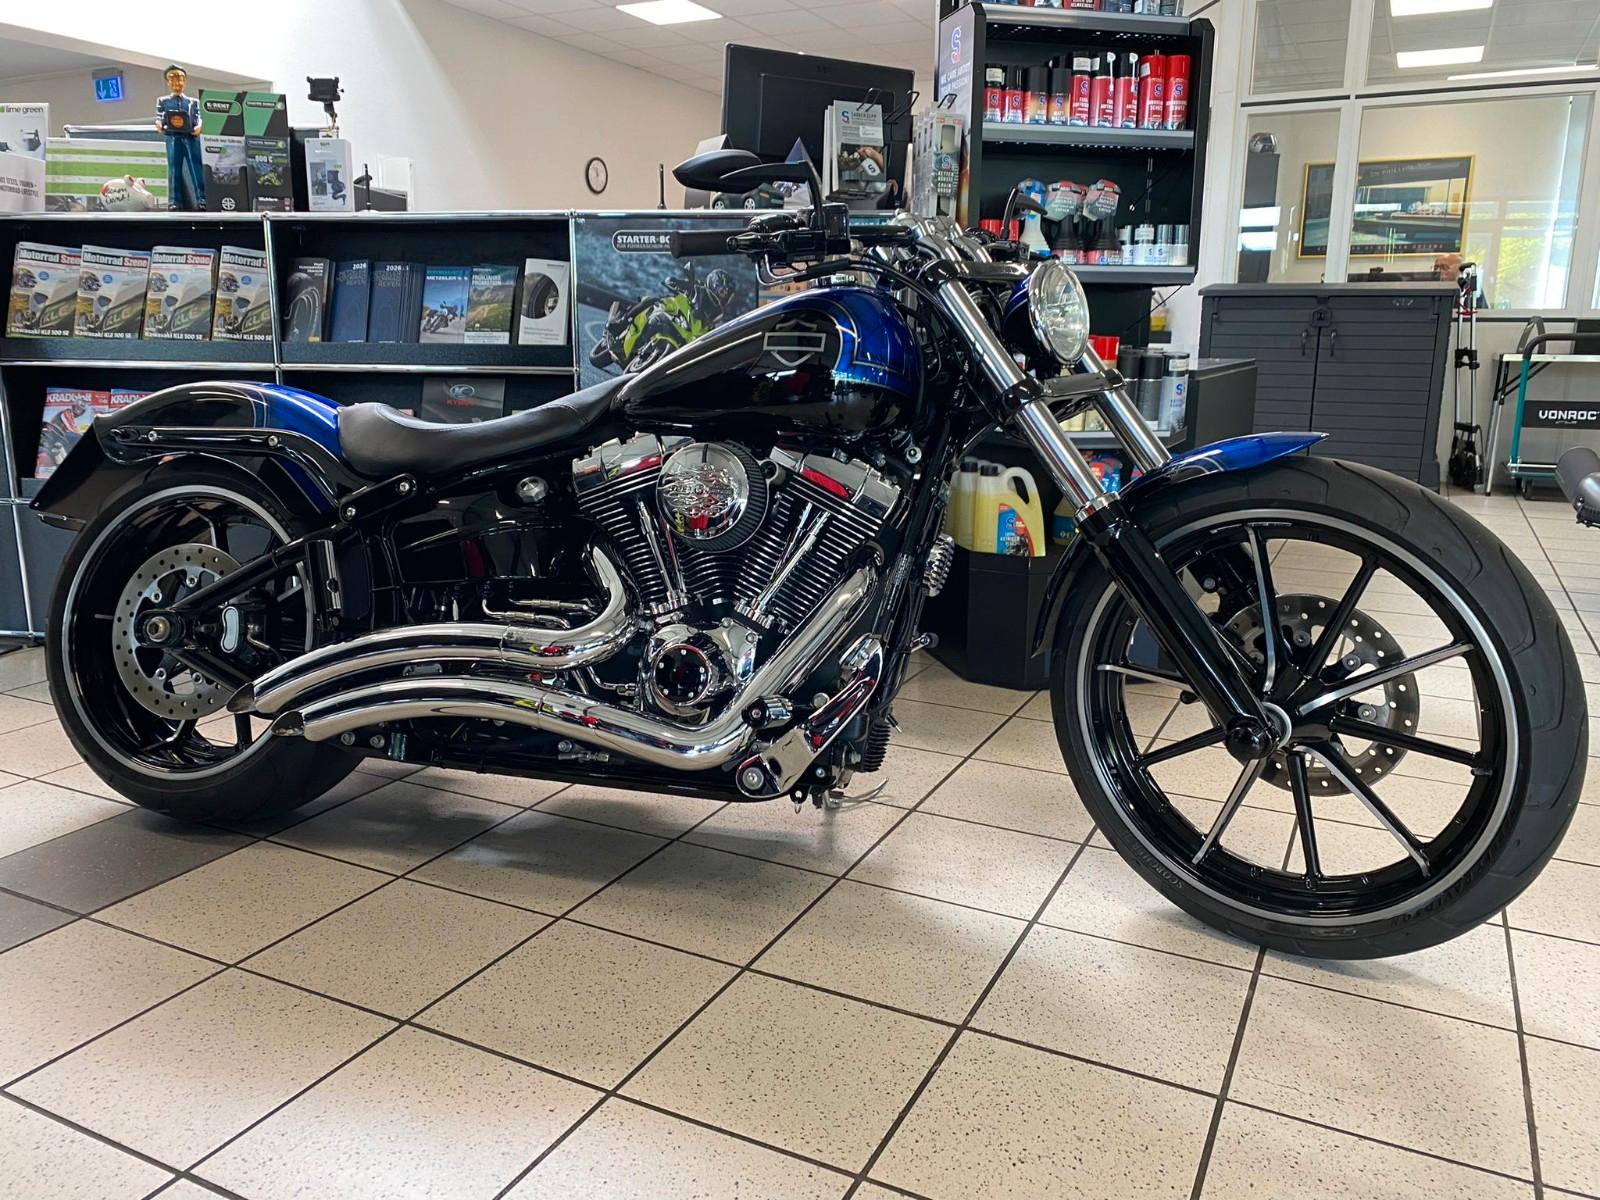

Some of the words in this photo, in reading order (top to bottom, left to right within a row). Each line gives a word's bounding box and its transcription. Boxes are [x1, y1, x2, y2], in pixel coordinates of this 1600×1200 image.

[22, 106, 44, 114] green
[20, 249, 59, 263] Motorrad
[83, 252, 123, 266] Motorrad
[124, 257, 148, 267] Szene
[153, 253, 187, 264] Motorrad
[187, 254, 211, 265] Szene
[222, 253, 262, 267] Motorrad
[1538, 409, 1598, 421] VONROC
